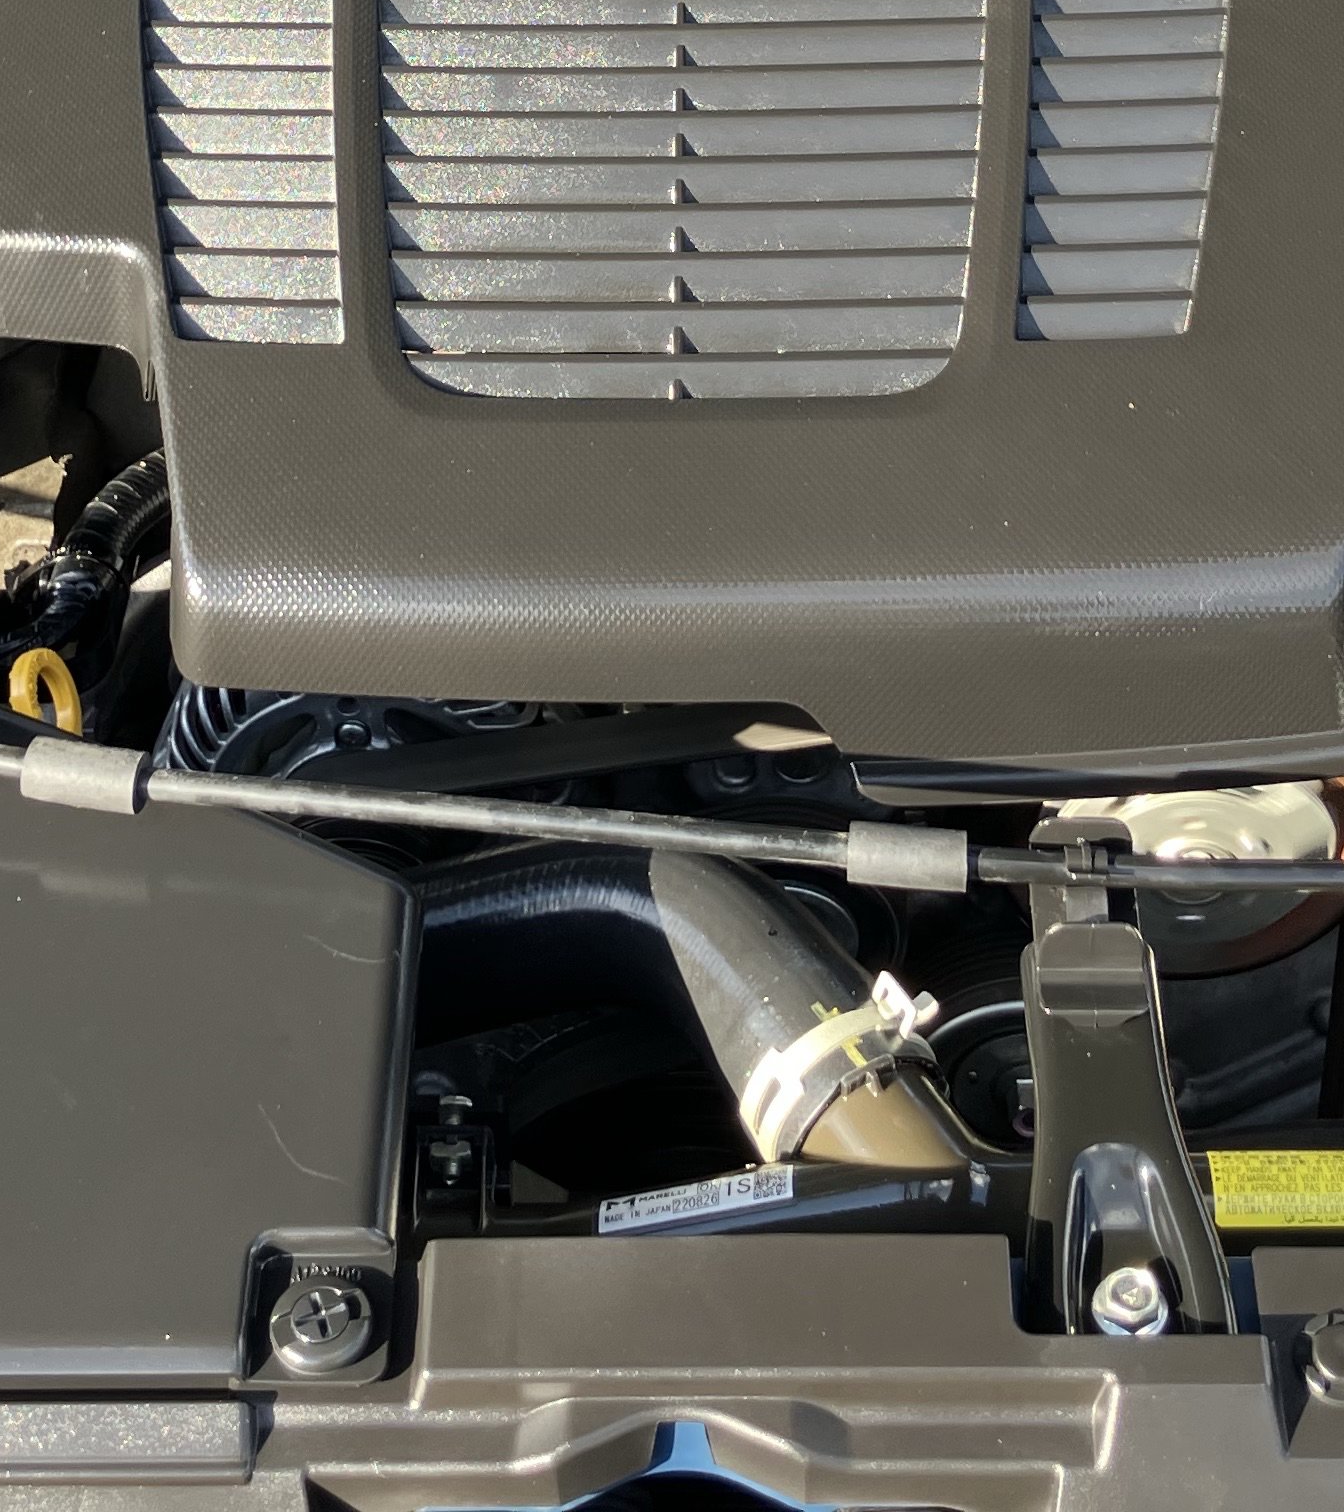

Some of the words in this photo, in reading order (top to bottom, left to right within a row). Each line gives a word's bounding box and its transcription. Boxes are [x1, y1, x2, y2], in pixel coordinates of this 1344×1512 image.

[1303, 1183, 1321, 1192] PAS
[1325, 1183, 1342, 1192] LES
[638, 1188, 687, 1203] MARELLI
[604, 1212, 624, 1224] MADE
[630, 1208, 641, 1218] IN
[645, 1204, 672, 1217] JAPAN
[674, 1192, 719, 1212] 220826
